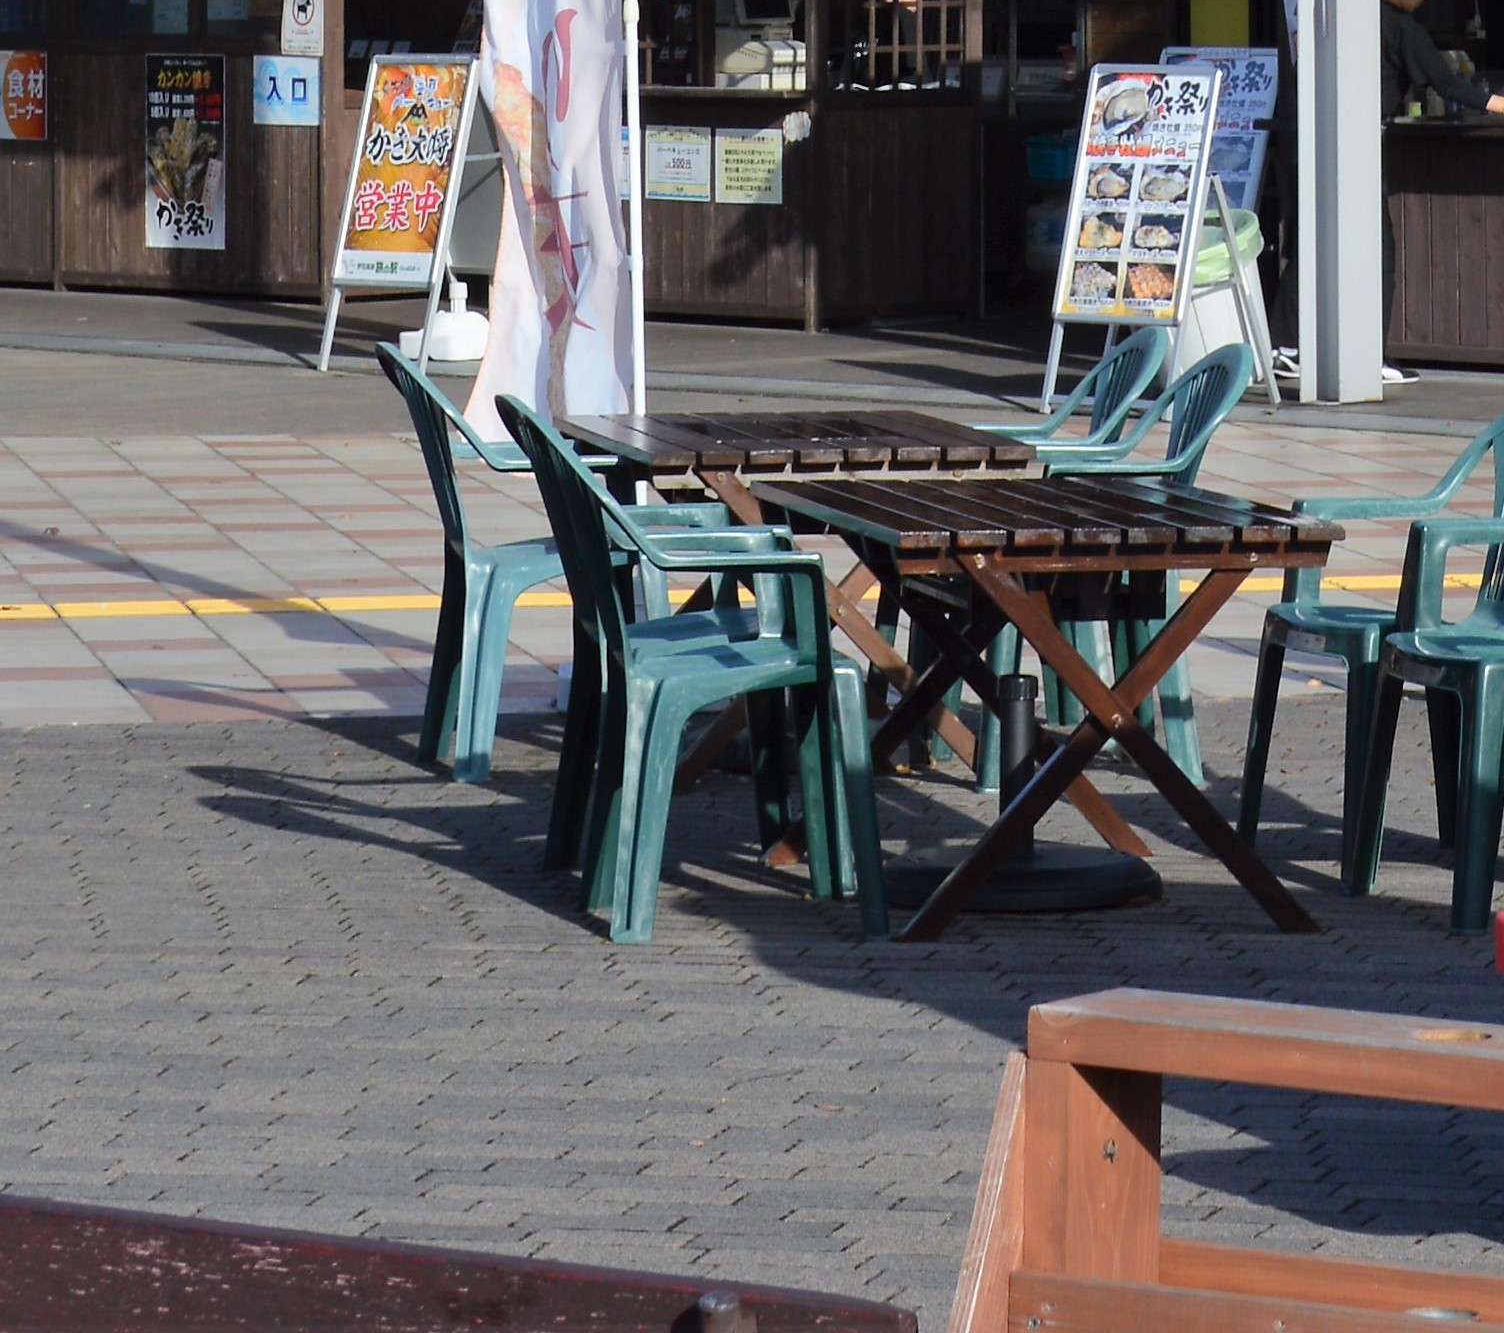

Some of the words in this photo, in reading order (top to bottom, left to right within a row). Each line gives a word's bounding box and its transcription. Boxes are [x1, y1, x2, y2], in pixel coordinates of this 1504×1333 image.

[8, 69, 45, 99] 食材
[266, 76, 307, 102] 入口
[1147, 80, 1208, 120] かき祭り
[8, 101, 43, 121] コーナー
[367, 125, 452, 165] かき大将
[156, 200, 214, 240] かき祭り
[355, 181, 444, 232] 営業中
